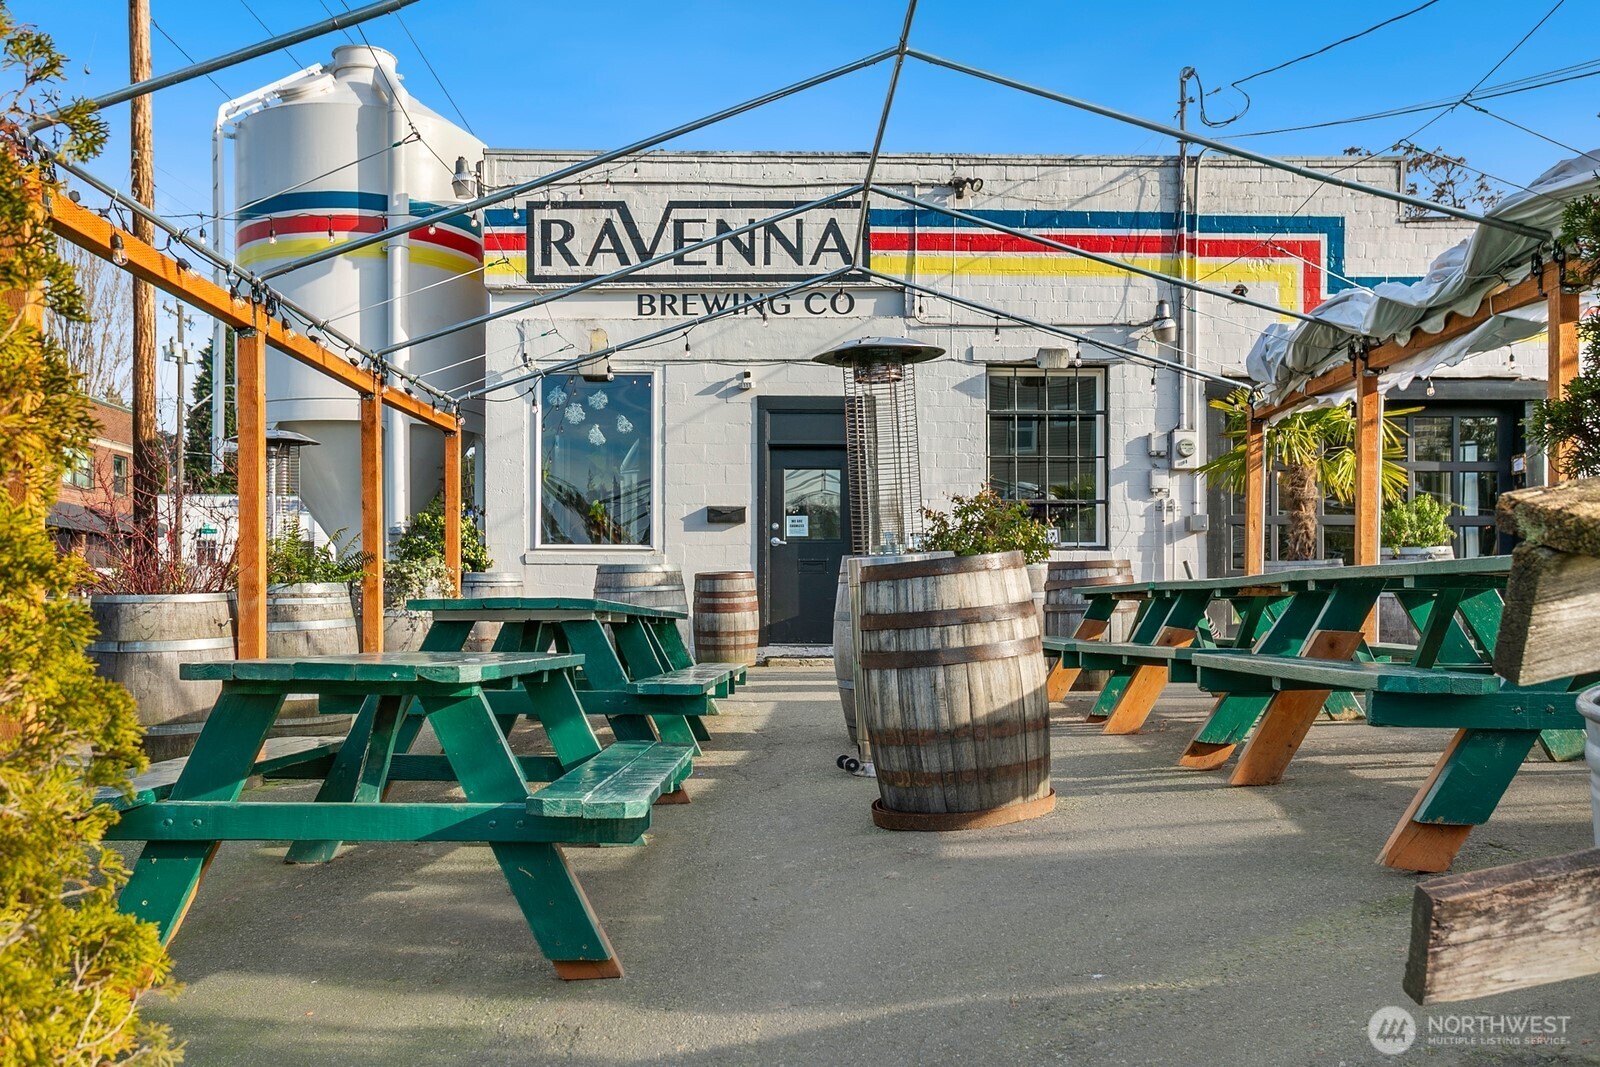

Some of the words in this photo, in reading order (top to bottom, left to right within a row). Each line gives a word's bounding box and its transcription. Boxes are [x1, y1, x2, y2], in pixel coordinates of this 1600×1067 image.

[540, 217, 854, 267] RAVENNA
[637, 292, 791, 317] BREWING
[804, 292, 855, 315] CO
